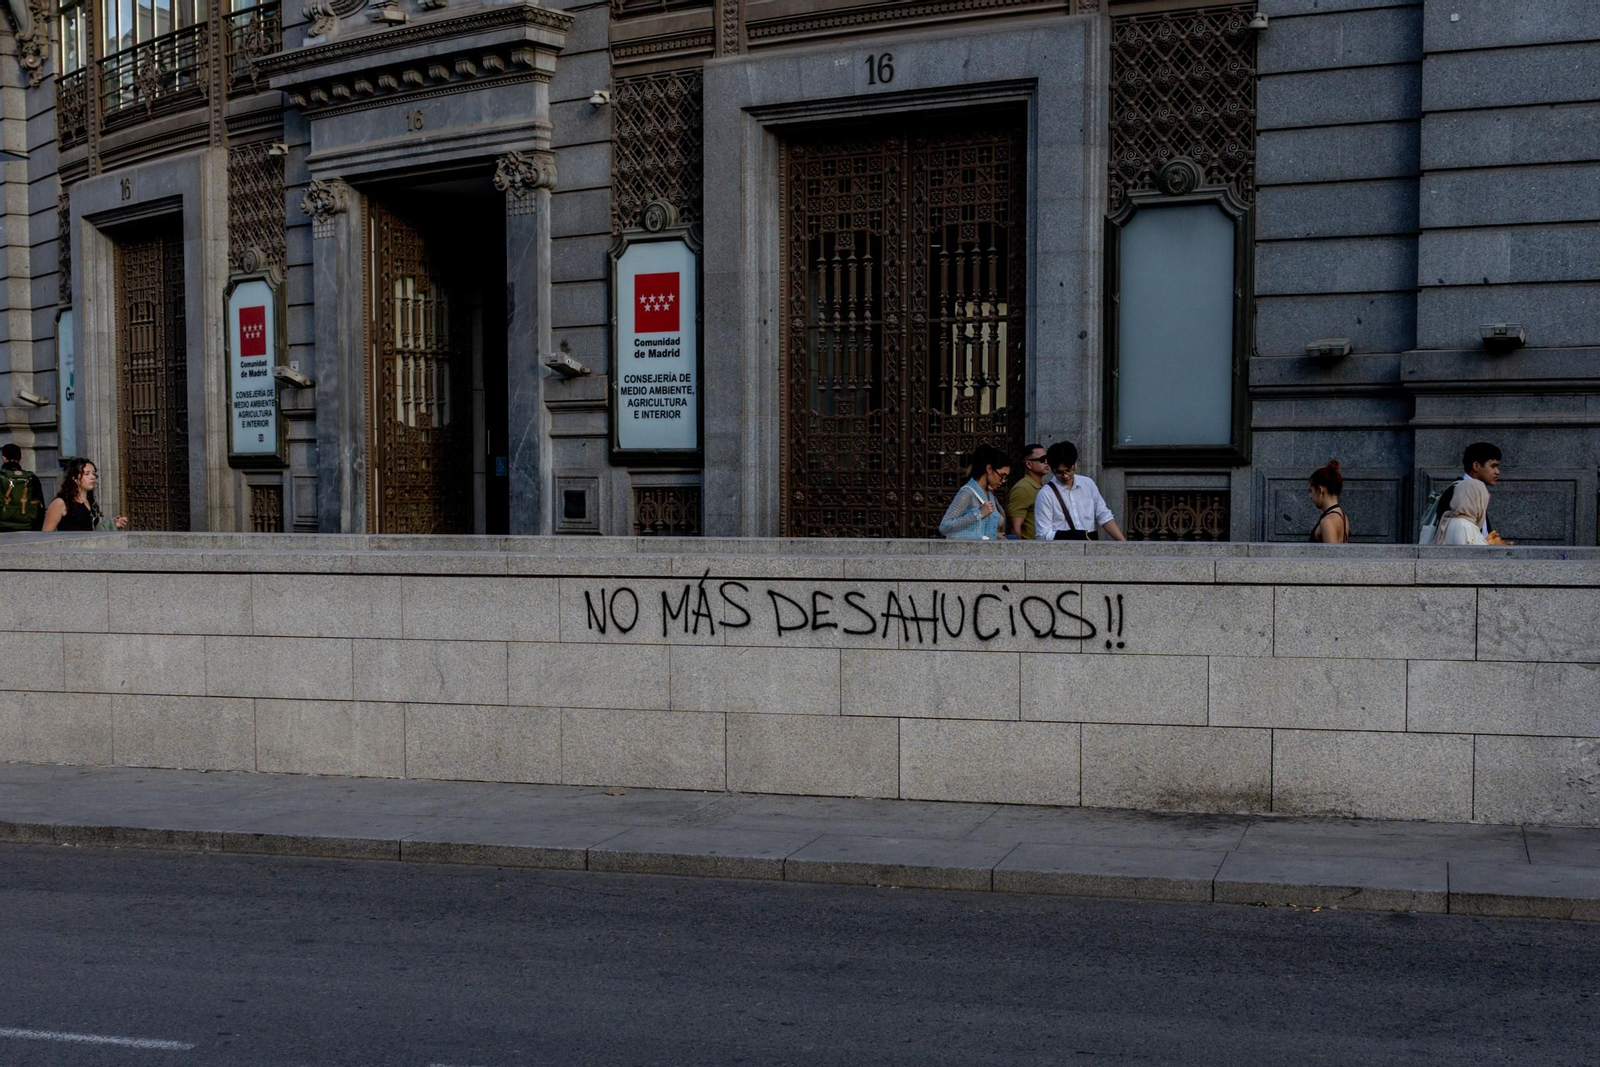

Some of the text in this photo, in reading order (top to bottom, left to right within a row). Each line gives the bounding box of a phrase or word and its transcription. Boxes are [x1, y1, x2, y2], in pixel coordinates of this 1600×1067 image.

[865, 53, 894, 85] 16
[406, 109, 424, 132] 16
[120, 178, 131, 201] 16
[634, 337, 681, 347] Comunidad
[634, 348, 680, 358] de Madrid
[240, 360, 267, 368] Comunidad
[249, 369, 267, 378] Madrid
[624, 372, 691, 383] CONSEJERÍA DE
[620, 386, 695, 395] MEDIO AMBIENTE,
[627, 398, 688, 407] AGRICULTURA
[238, 410, 272, 418] AGRICULTURA
[634, 410, 681, 419] E INTERIOR
[585, 587, 639, 634] NO
[661, 568, 751, 637] MÁS
